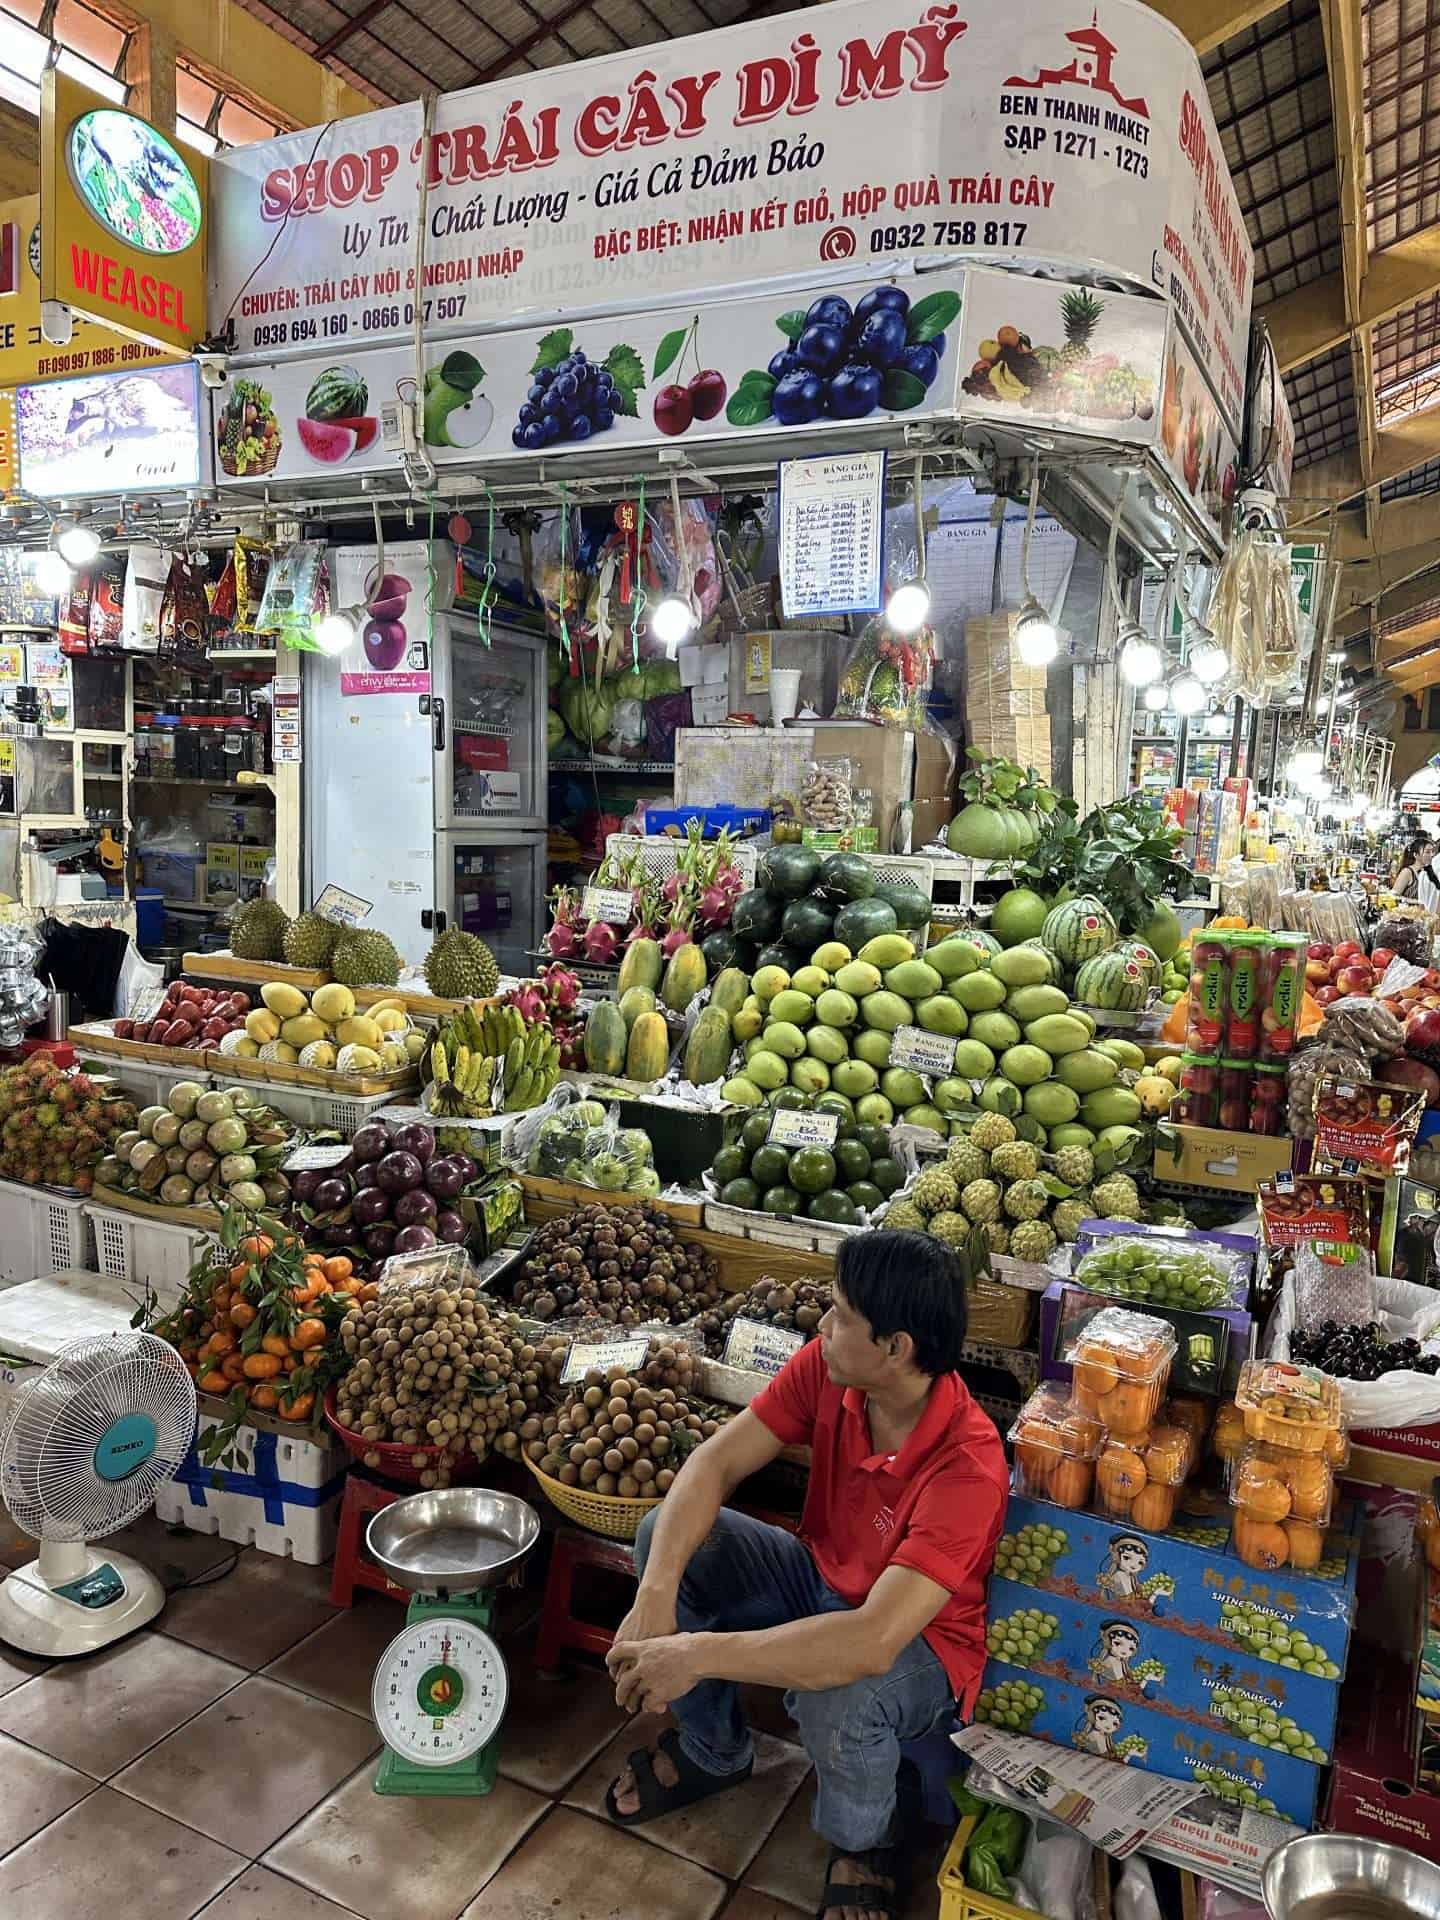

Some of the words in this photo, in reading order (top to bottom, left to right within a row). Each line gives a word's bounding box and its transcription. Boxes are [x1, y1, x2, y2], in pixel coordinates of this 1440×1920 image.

[260, 144, 400, 223] SHOP
[410, 99, 561, 192] TRÁI
[574, 70, 721, 157] CÂY
[733, 33, 822, 127] DÌ
[836, 3, 968, 107] MỸ
[1000, 95, 1038, 116] BEN
[1044, 97, 1100, 127] THANH
[1104, 110, 1150, 146] MAKET
[1003, 125, 1047, 154] SẠP
[1053, 130, 1097, 160] 1271
[1115, 145, 1149, 180] 1273
[342, 222, 372, 259] Uy
[378, 215, 410, 248] Tín
[431, 192, 486, 238] Chất
[492, 189, 569, 229] Lượng
[594, 167, 640, 208] Giá
[647, 157, 683, 198] Cả
[690, 148, 759, 190] Đảm
[766, 133, 825, 176] Bảo
[593, 223, 631, 261] ĐẶC
[636, 219, 682, 253] BIỆT:
[687, 209, 744, 244] NHẬN
[750, 196, 788, 233] KẾT
[793, 187, 835, 225] GIỎ,
[842, 183, 886, 220] HỘP
[894, 174, 940, 210] QUÀ
[948, 172, 1001, 206] TRÁI
[1009, 174, 1055, 209] CÂY
[870, 223, 925, 253] 0932
[932, 221, 976, 246] 758
[983, 222, 1027, 246] 817
[71, 243, 192, 333] WEASEL
[241, 284, 300, 317] CHUYÊN:
[303, 278, 337, 308] TRÁI
[340, 272, 369, 301] CÂY
[373, 267, 400, 298] NỘI
[406, 269, 415, 289] &
[421, 257, 473, 288] NGOẠI
[477, 247, 524, 281] NHẬP
[253, 322, 288, 347] 0938
[291, 319, 317, 341] 694
[322, 314, 348, 338] 160
[362, 306, 399, 331] 0866
[403, 301, 433, 326] 07
[438, 295, 468, 319] 507
[92, 347, 114, 366] 1886
[121, 344, 140, 361] 090
[1207, 972, 1218, 1010] rockit
[1236, 971, 1248, 1010] rockit
[1279, 980, 1292, 1017] rockit
[1211, 1592, 1248, 1609] SHINE
[1251, 1602, 1296, 1623] MUSCAT
[481, 1685, 488, 1697] 3
[1201, 1678, 1236, 1694] SHINE
[1239, 1689, 1284, 1709] MUSCAT
[434, 1736, 440, 1748] 6
[1183, 1756, 1218, 1773] SHINE
[1221, 1768, 1264, 1790] MUSCAT
